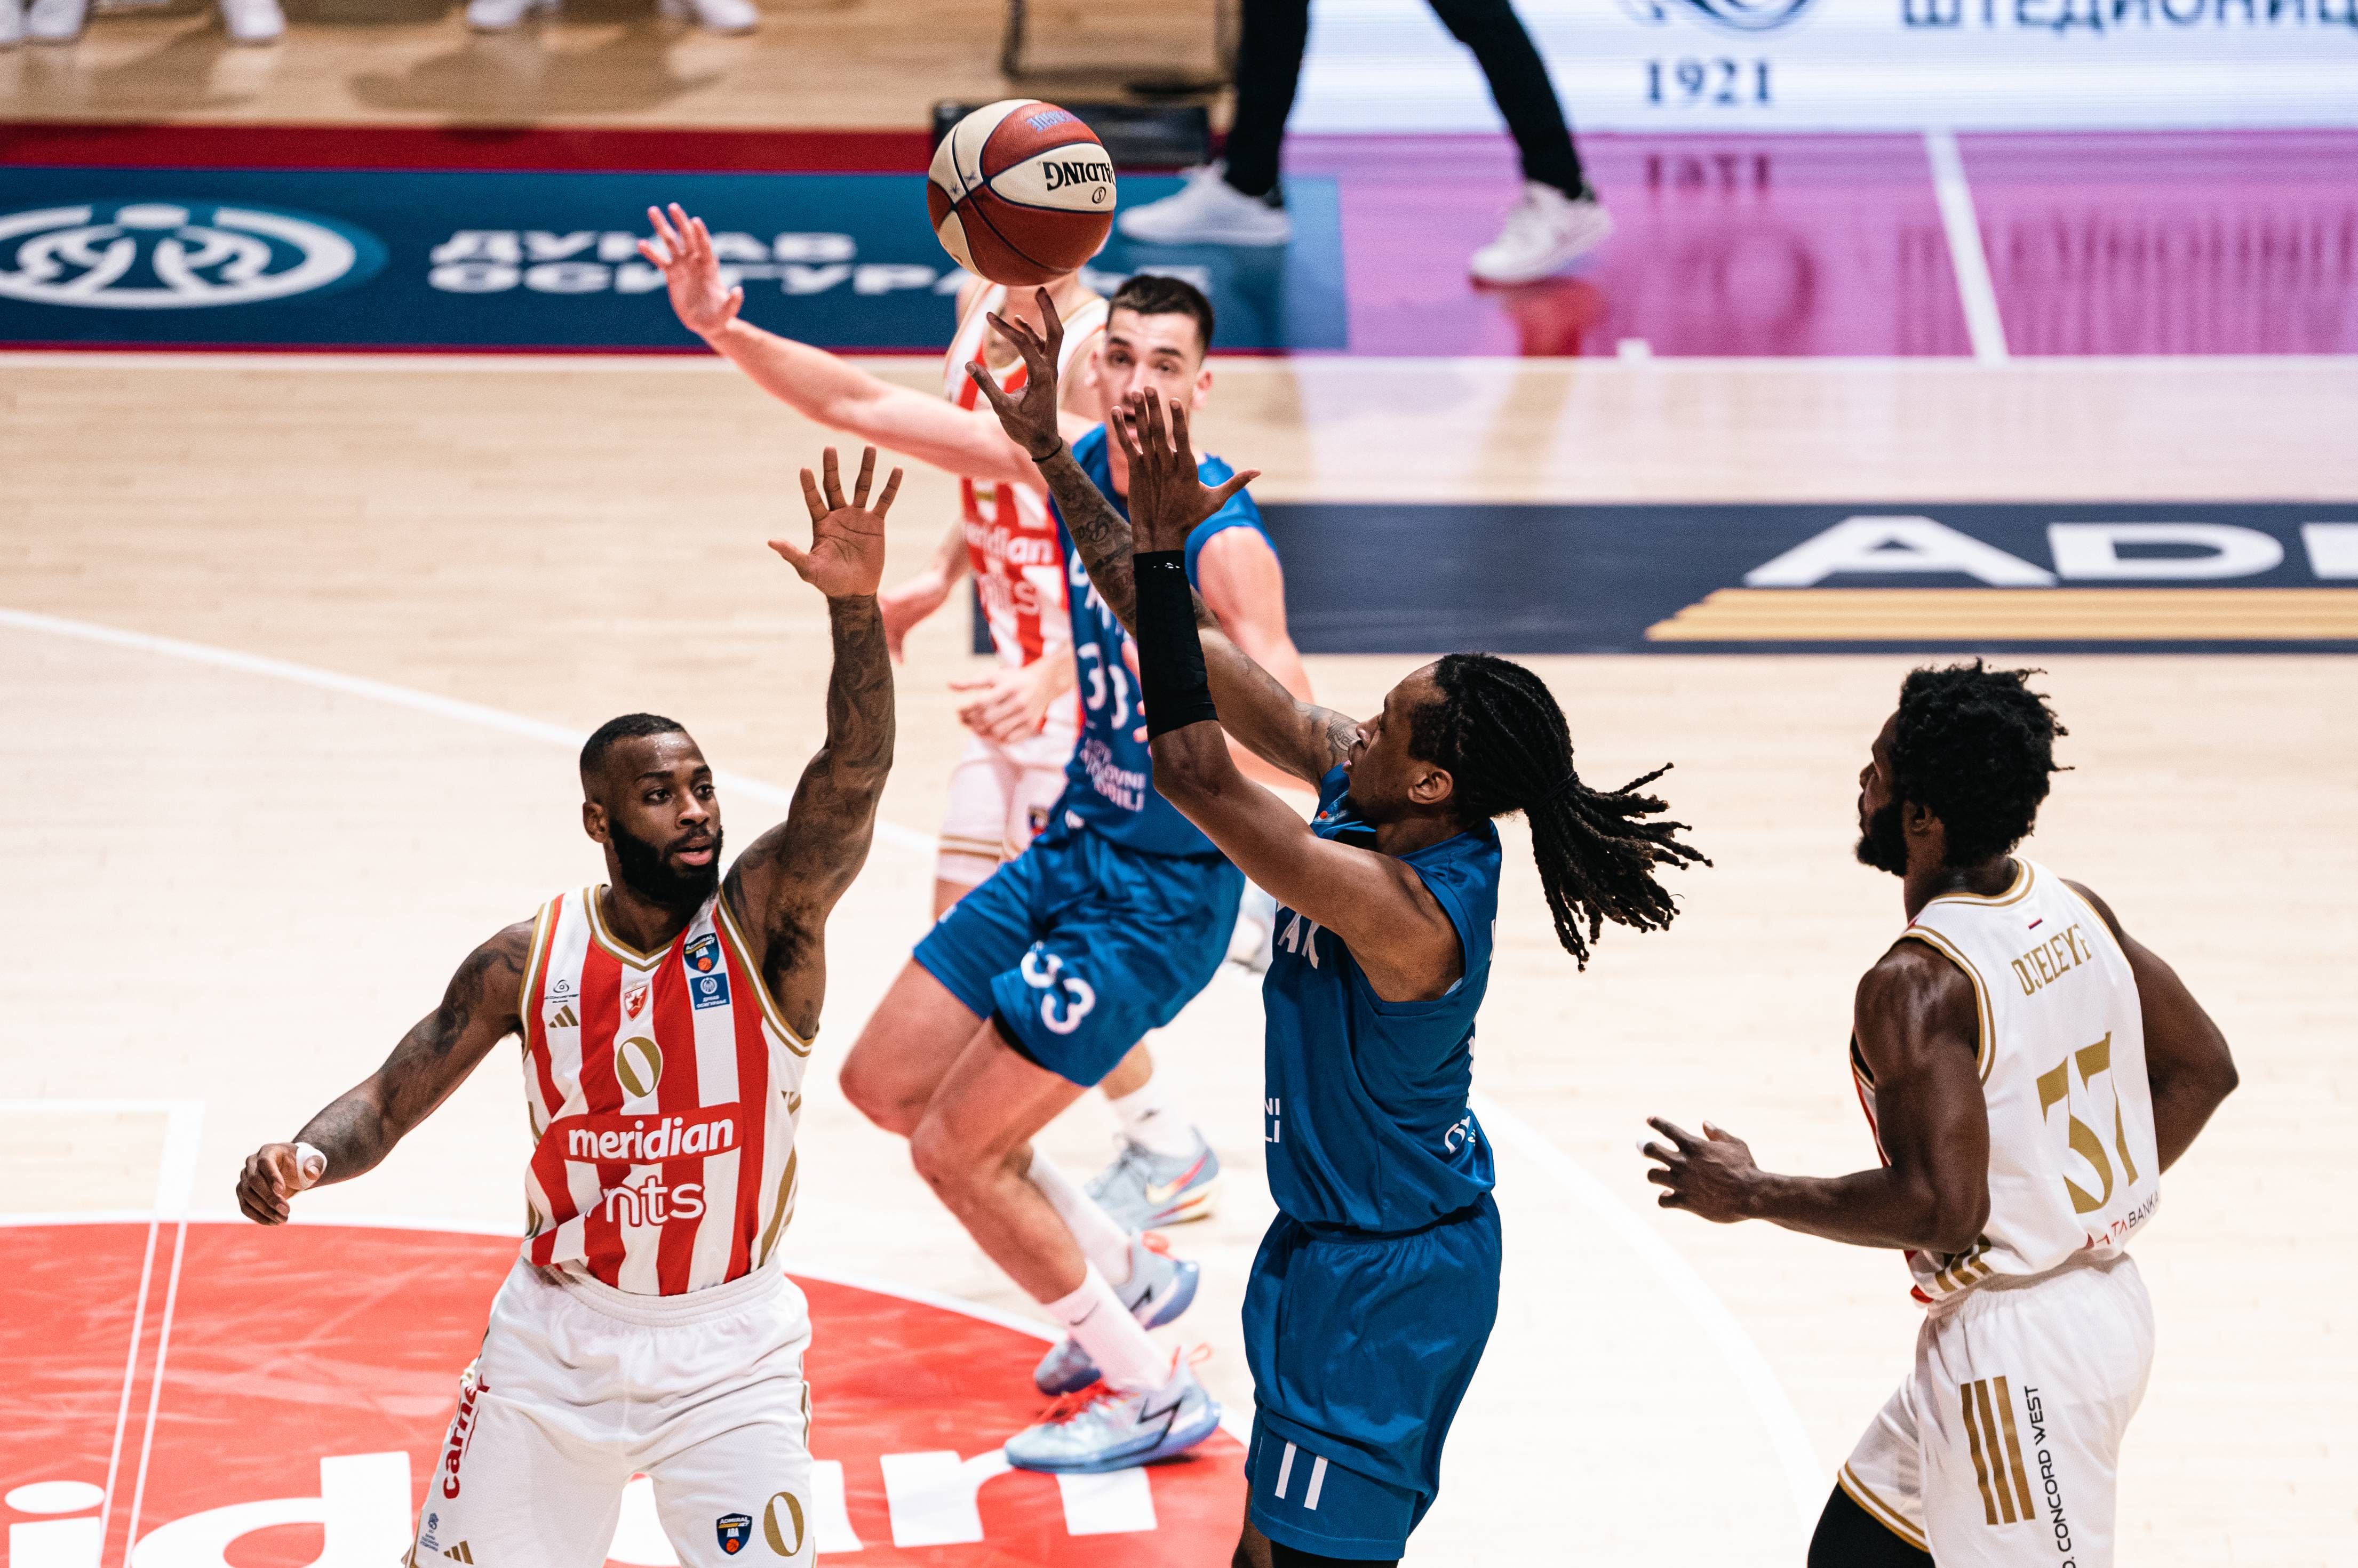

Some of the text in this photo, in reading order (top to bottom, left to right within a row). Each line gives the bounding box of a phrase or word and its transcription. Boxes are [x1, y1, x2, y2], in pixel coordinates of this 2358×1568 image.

[1646, 55, 1772, 105] 1921
[616, 1036, 663, 1098] 0
[568, 1116, 734, 1161] meridian
[2036, 1031, 2139, 1214] 37
[2024, 1385, 2046, 1446] WEST
[1274, 1441, 1329, 1511] 11
[2037, 1449, 2072, 1553] CONCORD
[763, 1491, 804, 1557] 0
